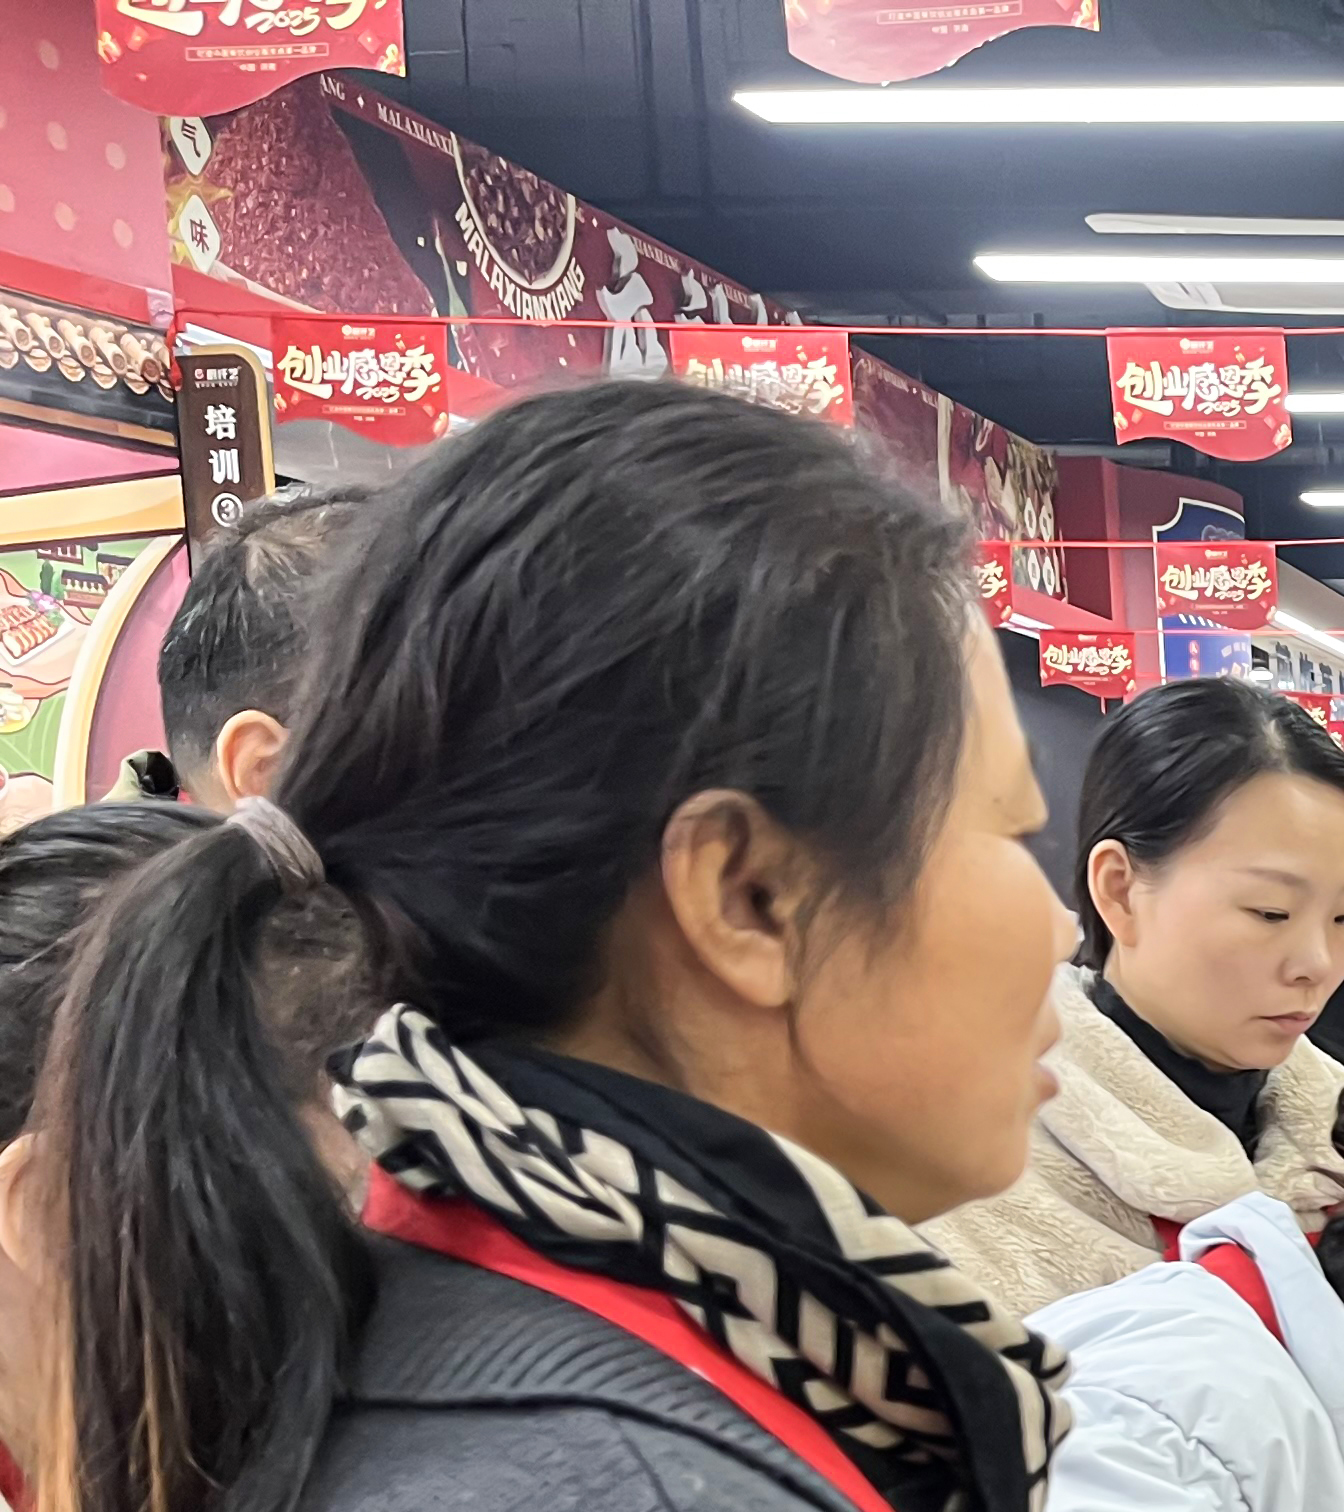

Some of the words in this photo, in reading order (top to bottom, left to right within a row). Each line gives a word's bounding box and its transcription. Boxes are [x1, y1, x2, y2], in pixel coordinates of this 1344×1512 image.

[277, 344, 442, 402] 创业感恩季
[1116, 356, 1282, 416] 创业感恩季
[1160, 560, 1271, 601] 创业感恩季
